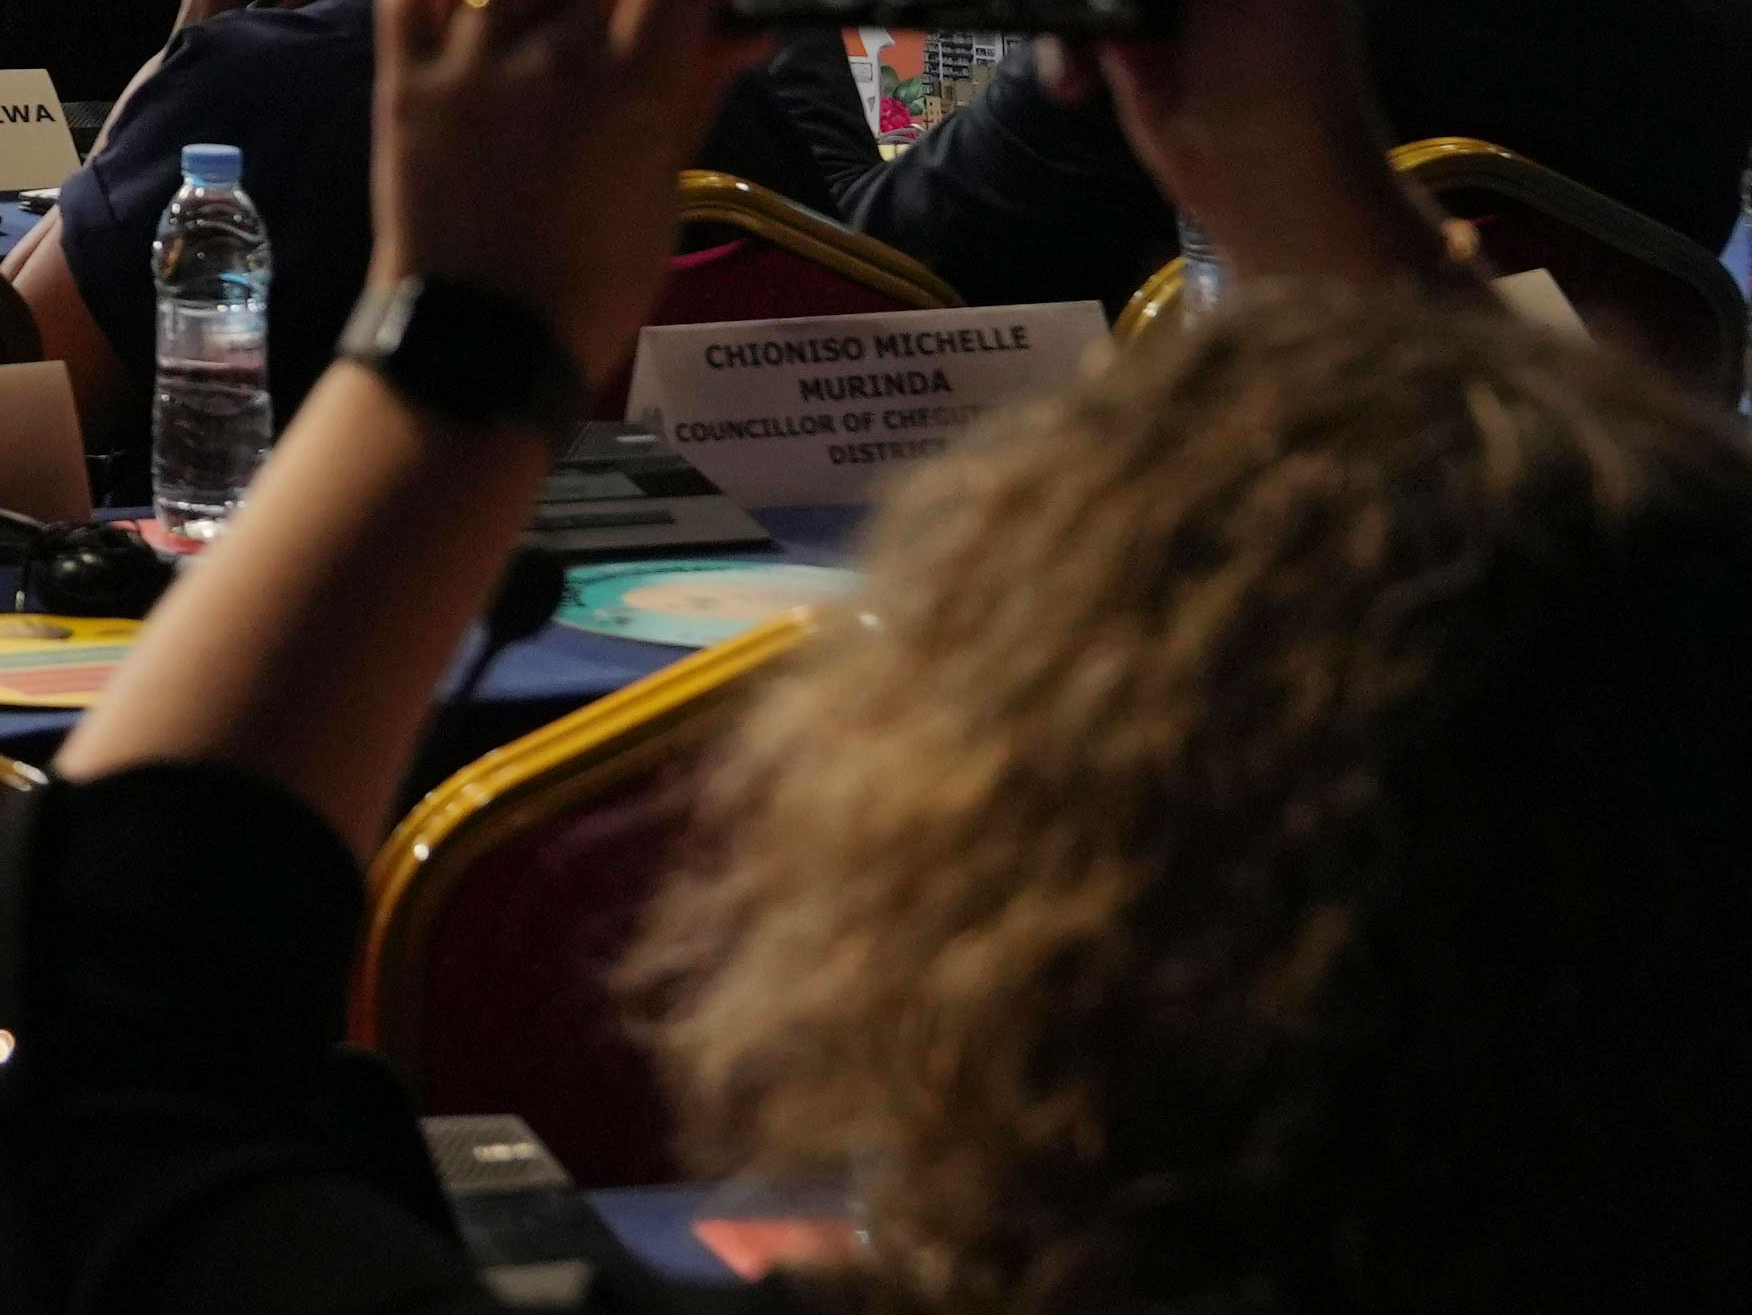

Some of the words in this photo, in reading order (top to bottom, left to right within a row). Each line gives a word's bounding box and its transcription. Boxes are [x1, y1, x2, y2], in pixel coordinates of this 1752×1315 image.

[705, 336, 863, 369] CHIONISO
[876, 325, 1030, 358] MICHELLE
[799, 370, 953, 403] MURINDA
[676, 414, 832, 443] COUNCILLOR
[844, 411, 874, 434] OF
